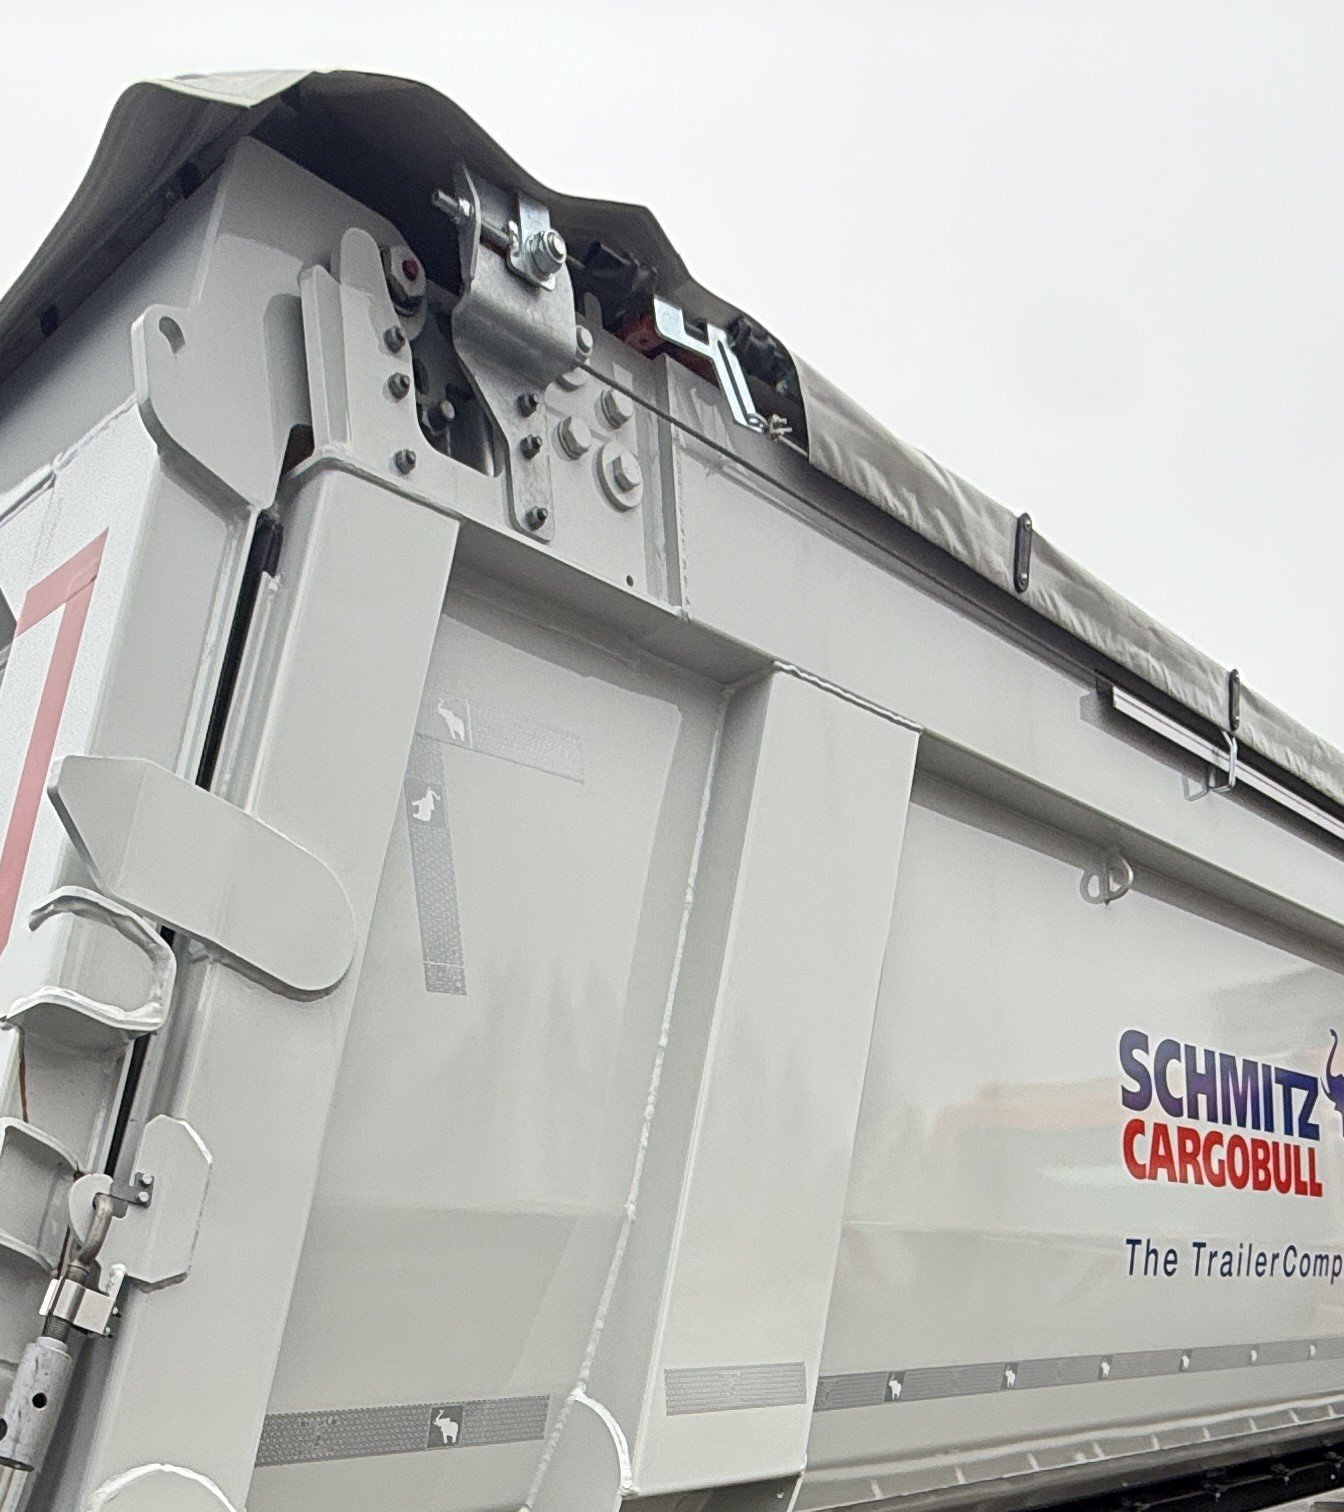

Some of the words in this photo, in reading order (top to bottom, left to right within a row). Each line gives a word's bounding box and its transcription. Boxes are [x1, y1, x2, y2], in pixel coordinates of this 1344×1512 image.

[1119, 1029, 1320, 1141] SCHMITZ
[1123, 1118, 1323, 1198] CARGOBULL
[1125, 1238, 1178, 1278] The
